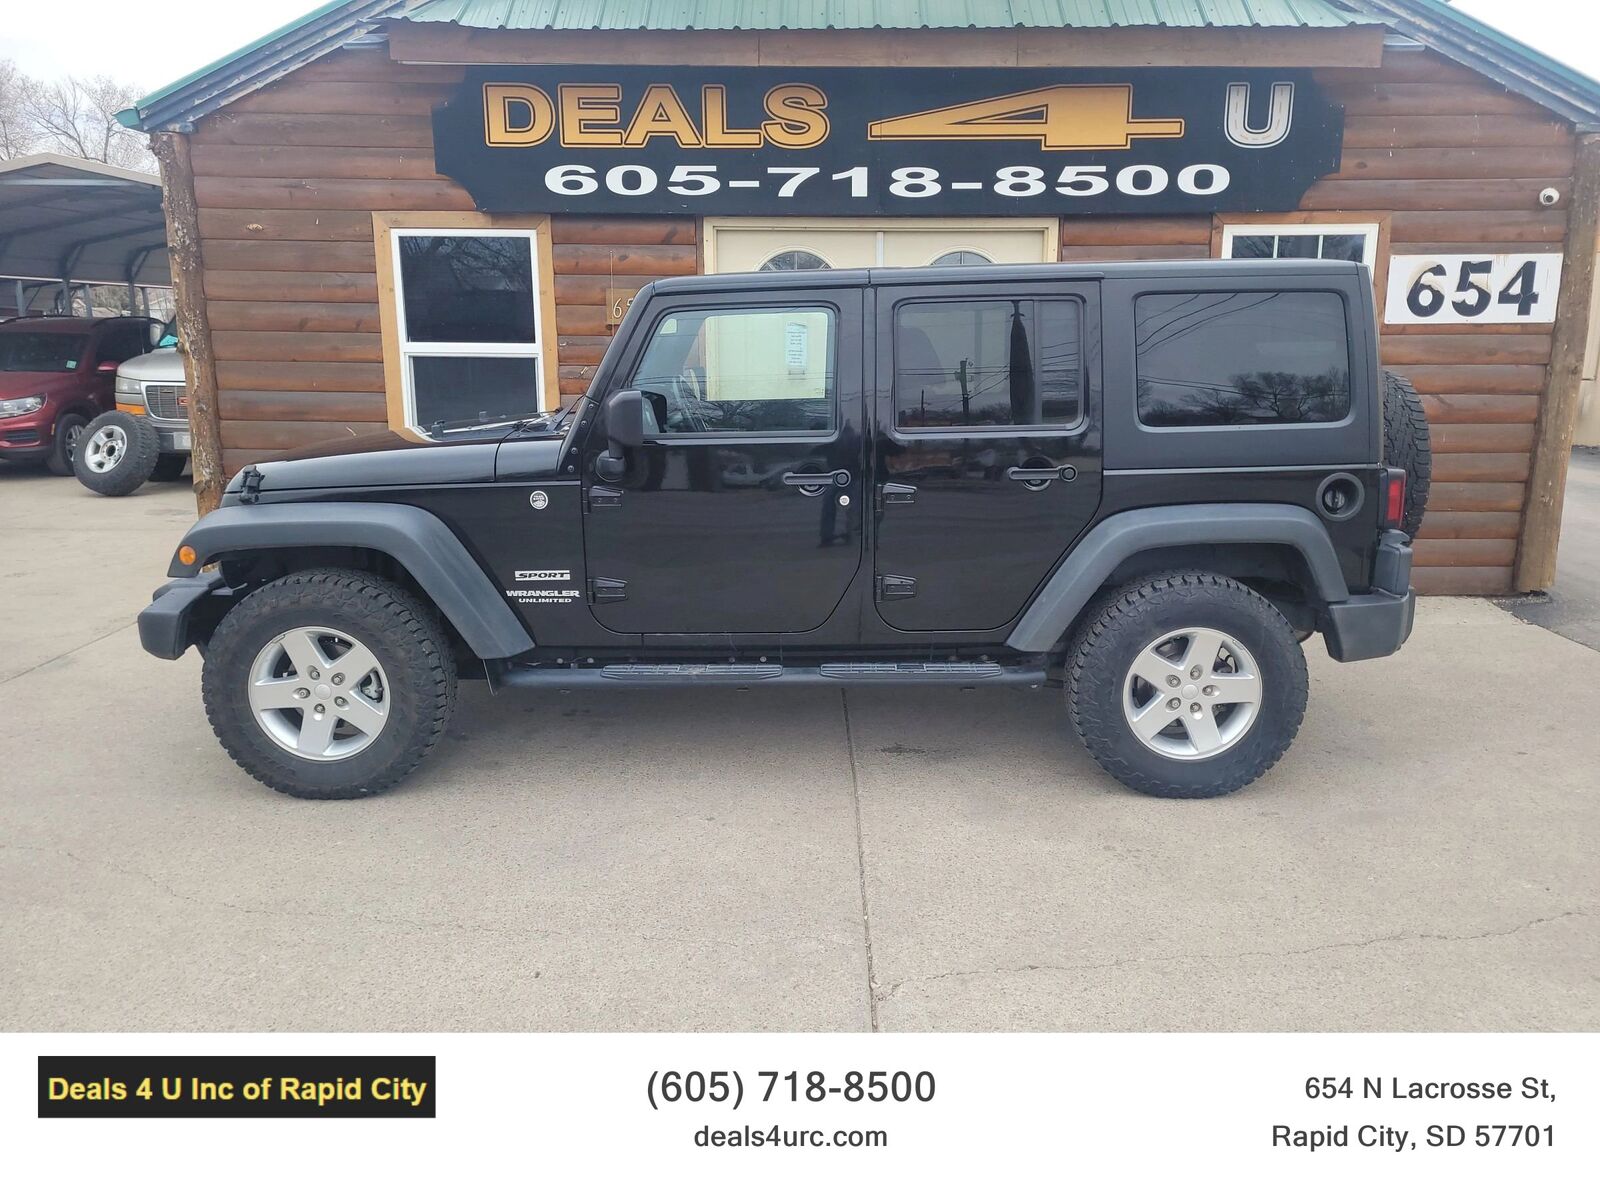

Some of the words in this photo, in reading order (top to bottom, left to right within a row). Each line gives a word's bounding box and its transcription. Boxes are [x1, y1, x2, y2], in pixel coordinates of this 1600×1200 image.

[482, 82, 830, 150] DEALS
[866, 83, 1186, 151] 4
[1223, 81, 1295, 149] U
[544, 163, 1231, 199] 605-718-8500
[1406, 260, 1539, 317] 654
[516, 571, 568, 580] SPORT
